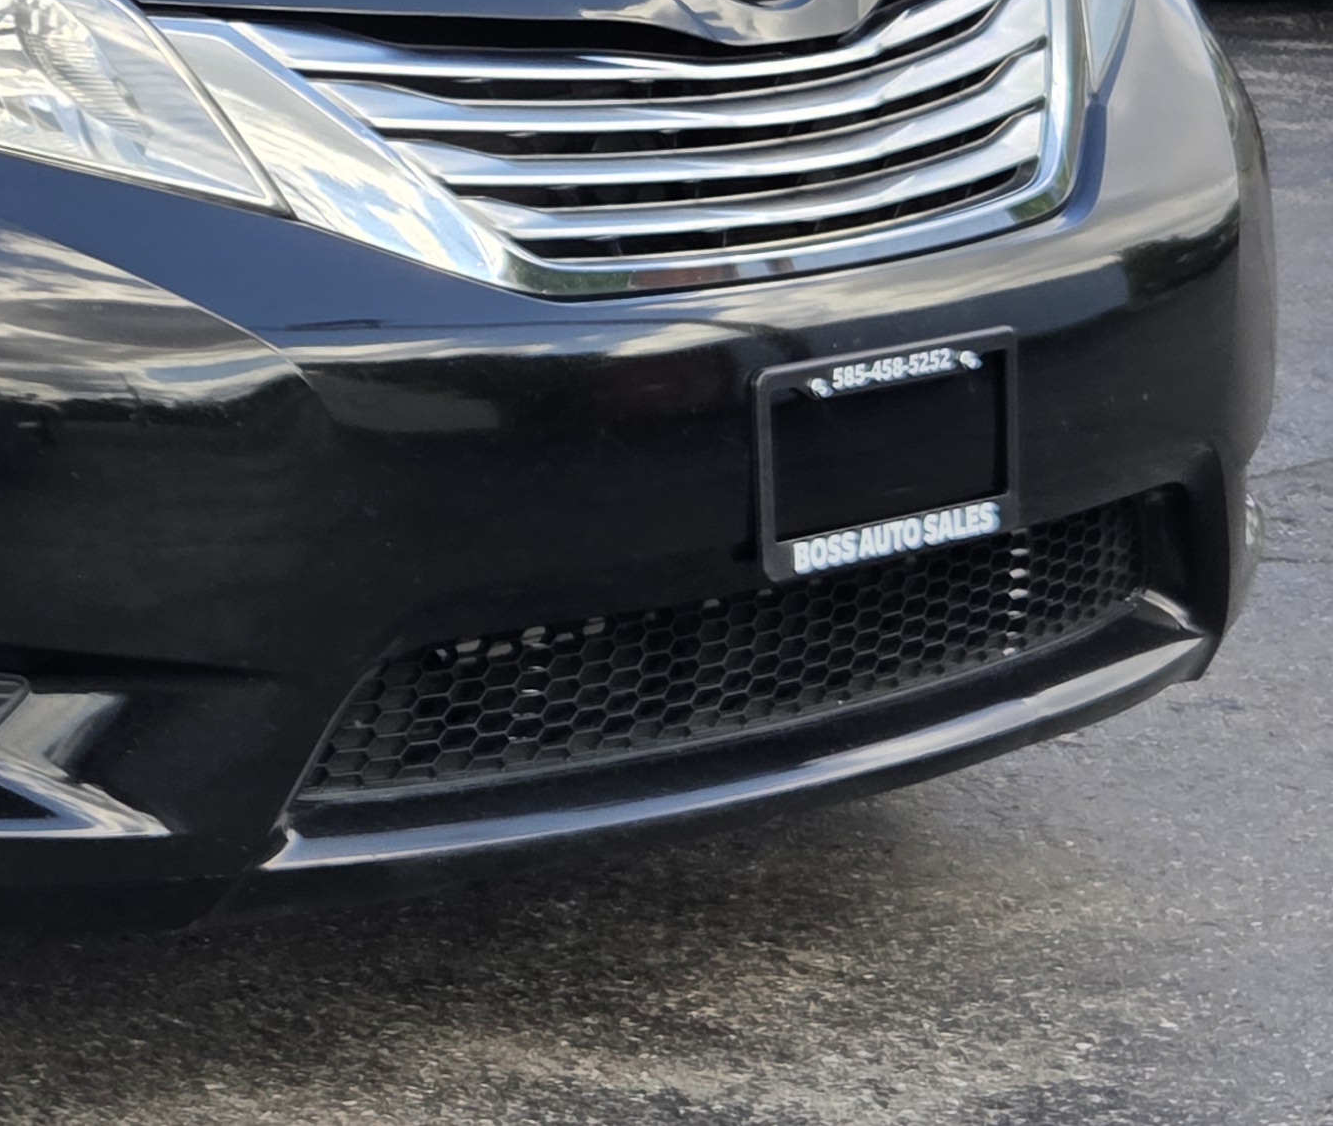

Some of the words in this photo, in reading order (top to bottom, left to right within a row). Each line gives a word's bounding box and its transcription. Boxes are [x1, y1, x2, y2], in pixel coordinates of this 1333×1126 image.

[832, 348, 956, 391] 585-458-5252
[793, 531, 859, 574] BOSS
[858, 517, 924, 559] AUTO
[923, 501, 1001, 546] SALES
